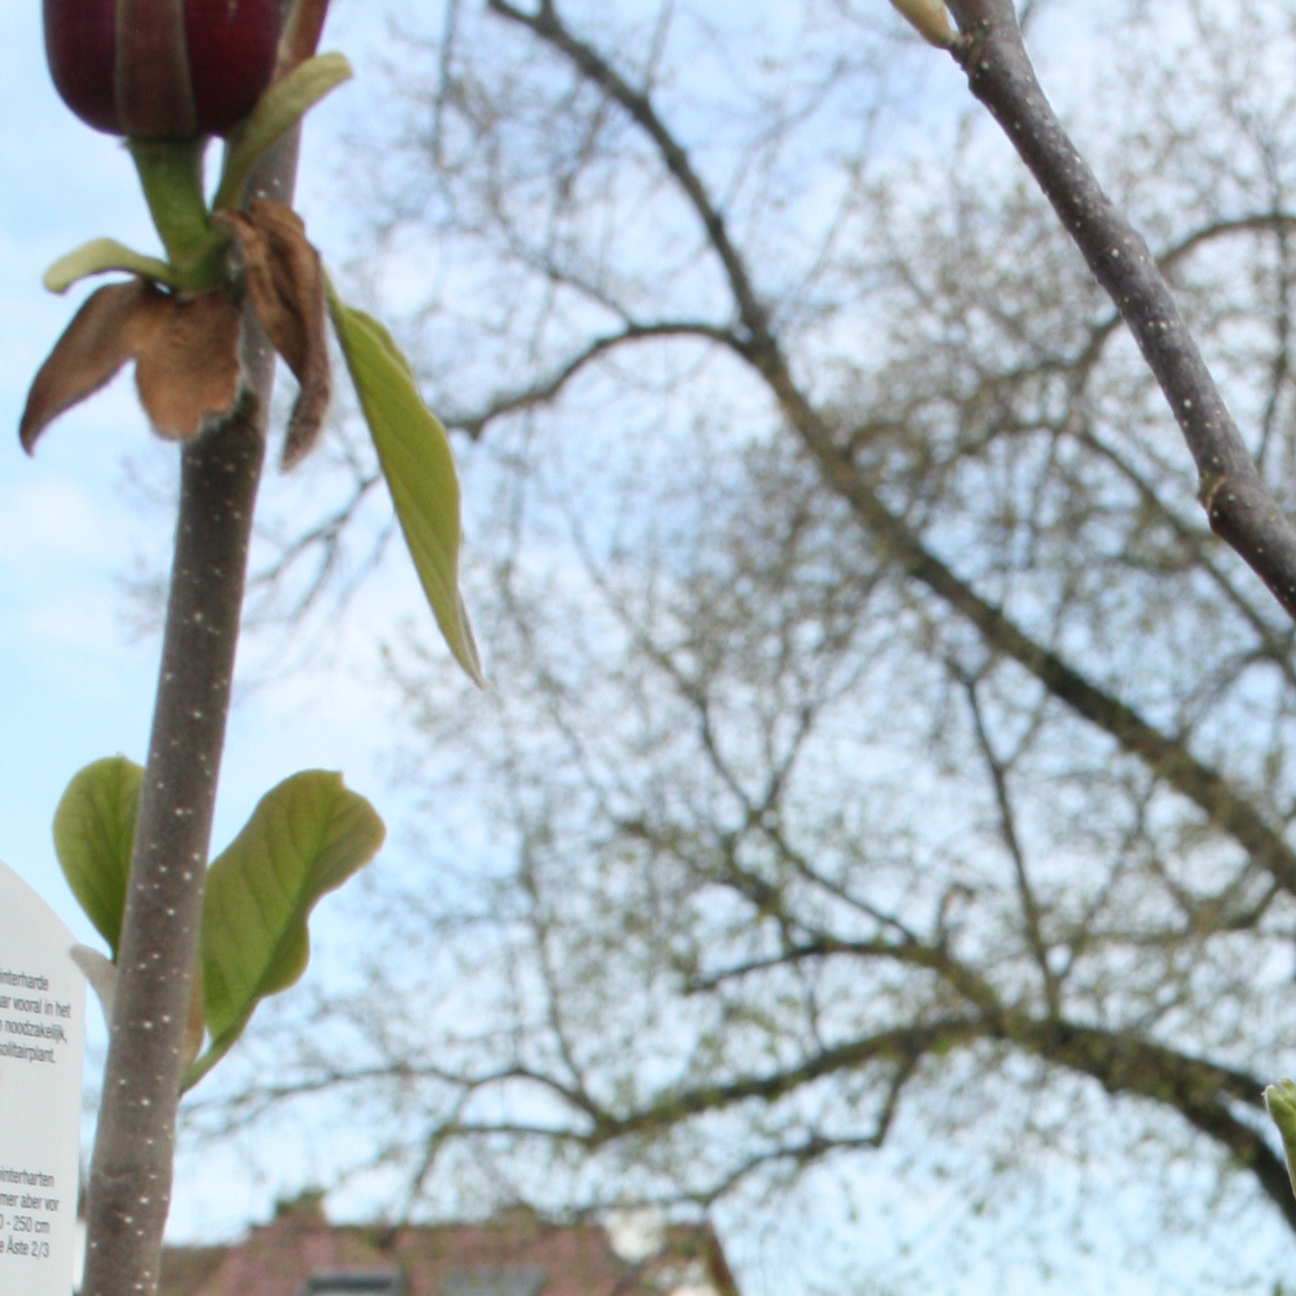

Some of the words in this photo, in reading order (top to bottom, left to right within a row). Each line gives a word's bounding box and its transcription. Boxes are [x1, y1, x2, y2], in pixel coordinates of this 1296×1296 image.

[13, 998, 42, 1014] vooral
[45, 999, 53, 1015] in
[55, 1000, 71, 1018] het
[20, 1193, 43, 1210] aber
[44, 1199, 60, 1211] vor
[13, 1214, 33, 1232] 250
[34, 1220, 50, 1233] cm
[31, 1240, 50, 1259] 2/3
